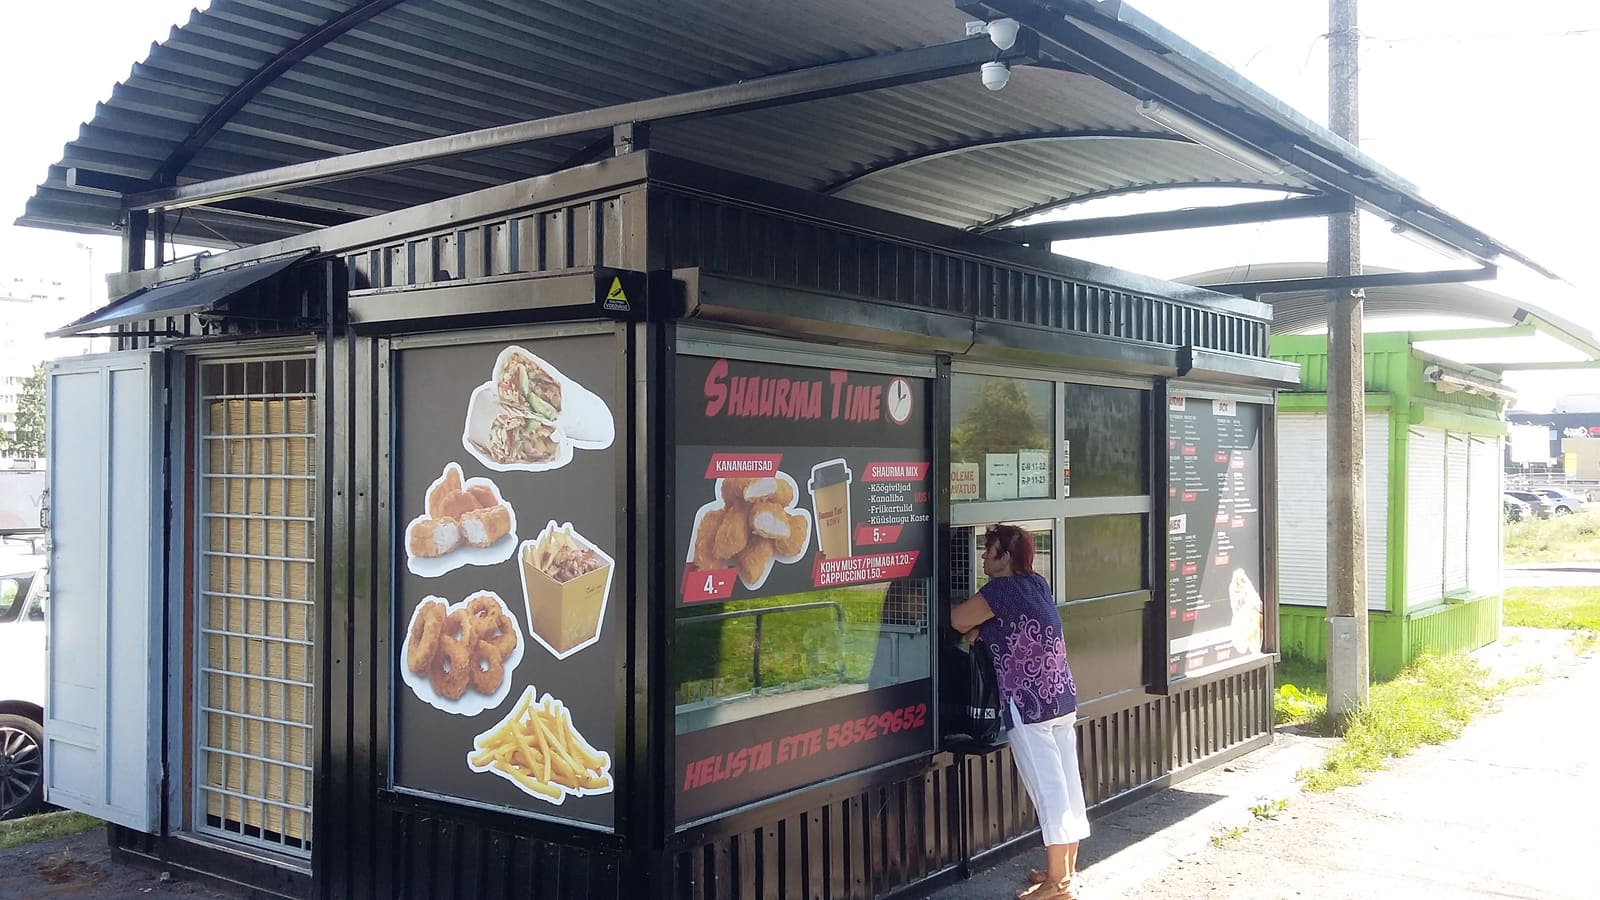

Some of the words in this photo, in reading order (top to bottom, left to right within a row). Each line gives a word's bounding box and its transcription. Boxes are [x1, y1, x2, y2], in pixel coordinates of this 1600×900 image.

[704, 358, 823, 420] SHAURMA
[829, 369, 882, 423] TIME
[716, 460, 773, 472] KANANAGITSAD
[871, 466, 905, 478] SHAURMA
[905, 466, 919, 477] MIX
[950, 471, 974, 482] OLEME
[910, 514, 930, 523] Kaste
[873, 528, 887, 542] 5.-
[820, 560, 840, 574] KOHV
[704, 574, 725, 594] 4.-
[820, 570, 867, 585] CAPPUCCINO
[684, 742, 772, 791] HELISTA
[776, 727, 825, 765] ETTE
[825, 703, 927, 751] 58529652
